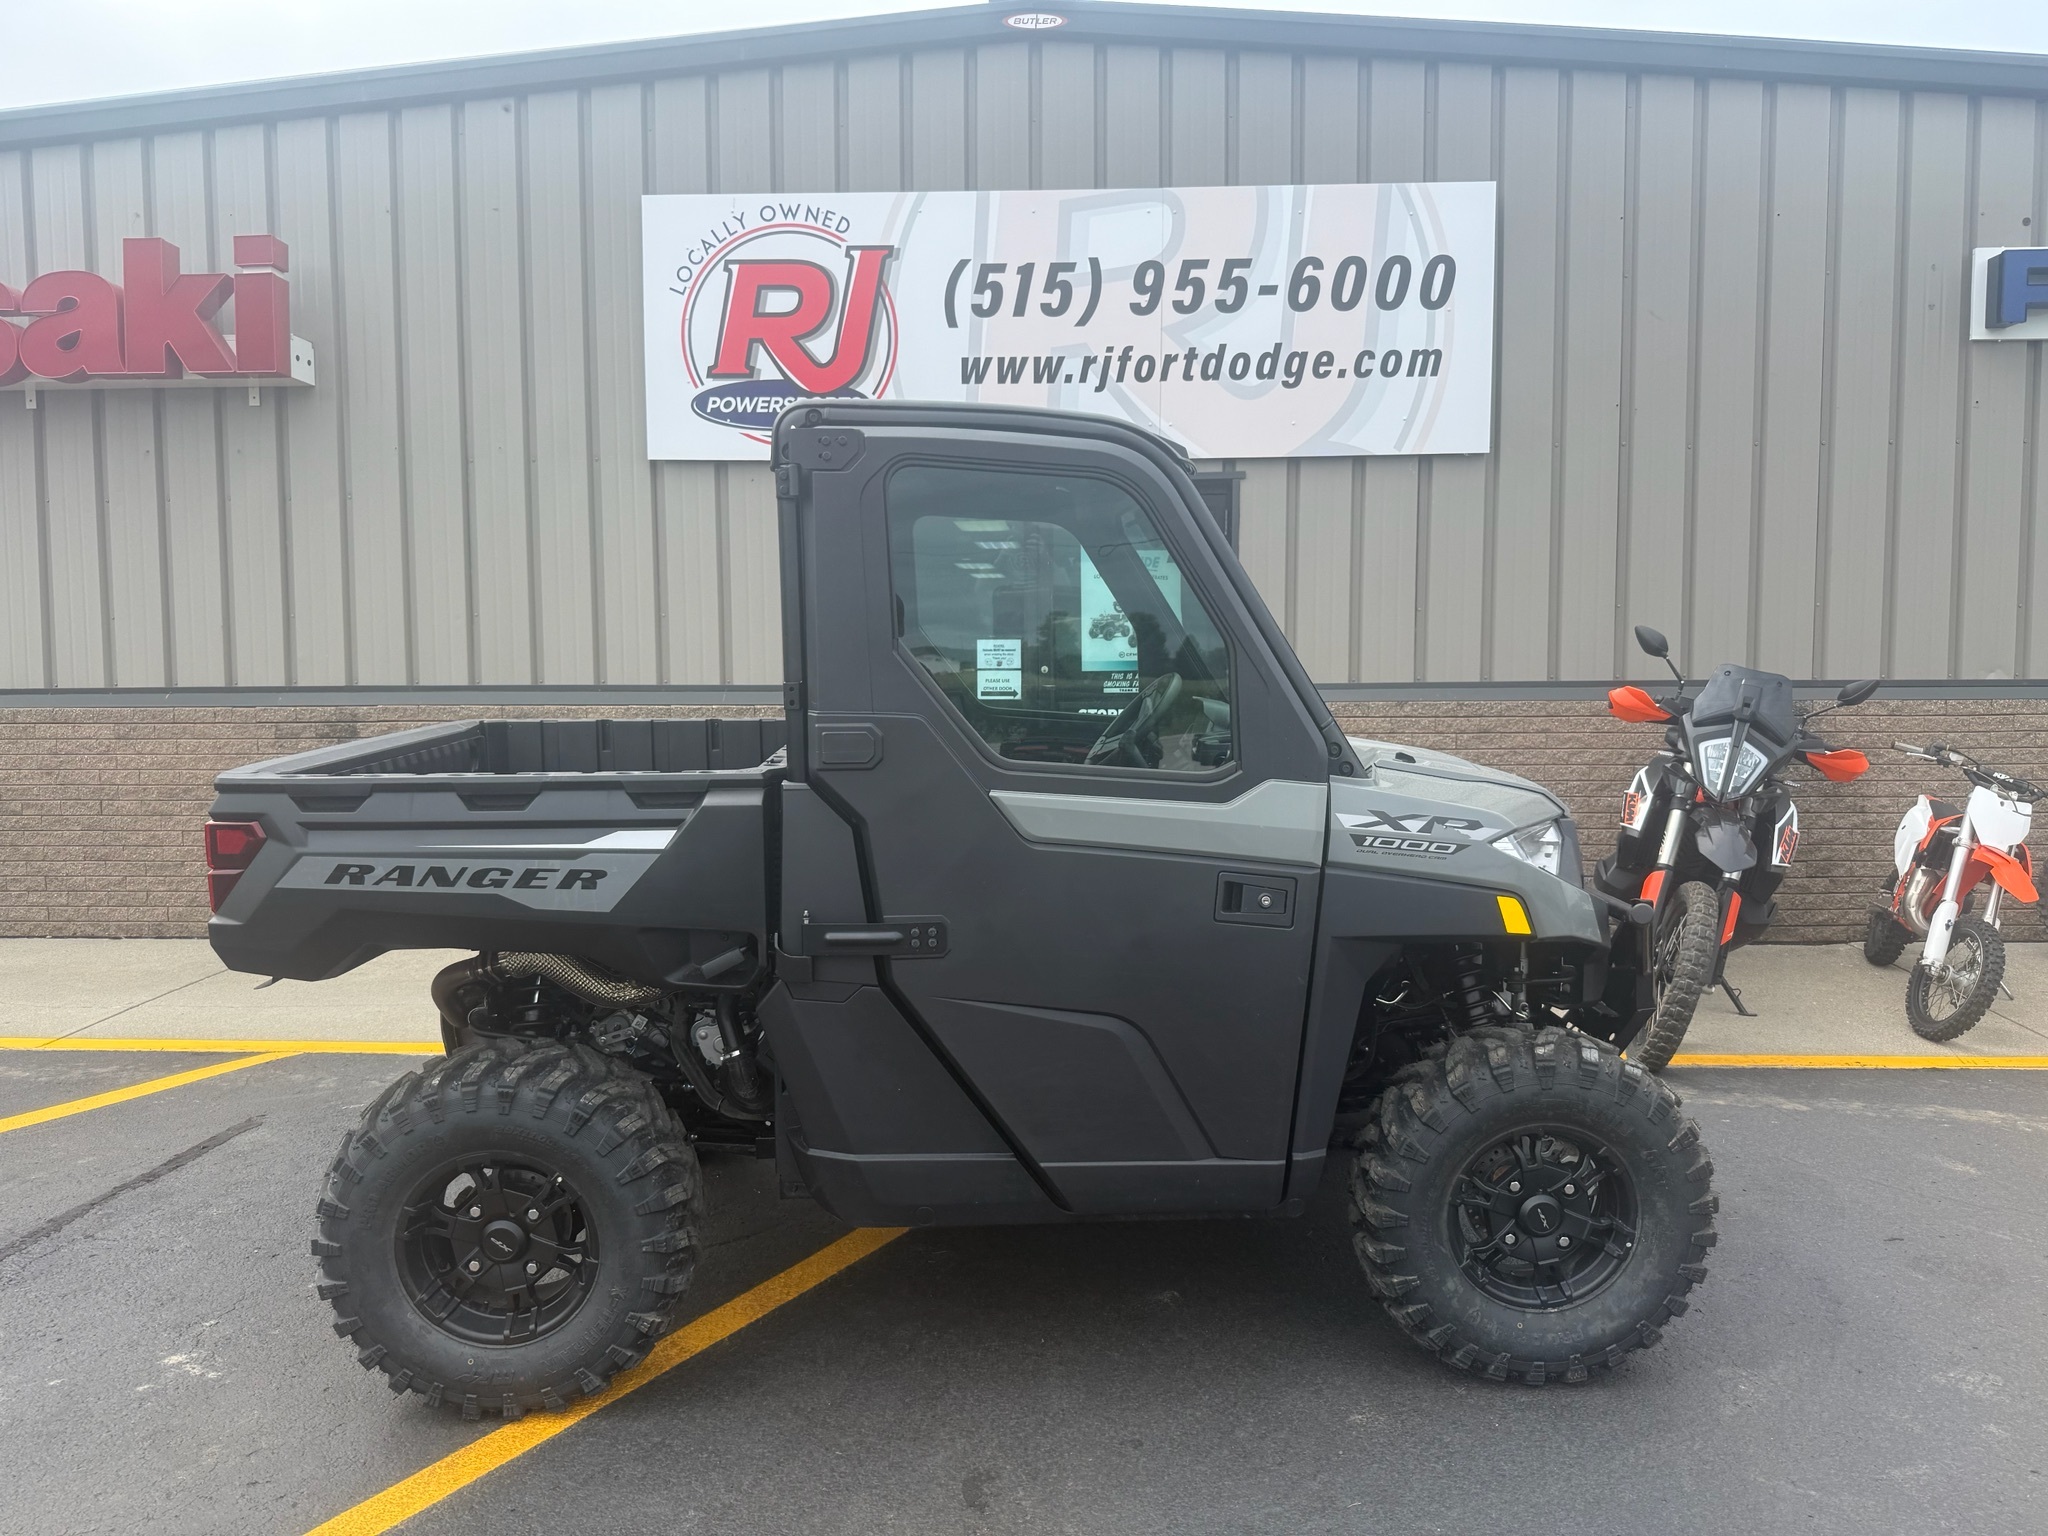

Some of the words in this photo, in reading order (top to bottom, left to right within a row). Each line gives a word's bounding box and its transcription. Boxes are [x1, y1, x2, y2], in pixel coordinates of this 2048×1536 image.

[1013, 17, 1058, 25] BUTLER
[669, 212, 747, 296] LOCALLY
[759, 203, 851, 234] OWNED
[944, 257, 1102, 328] (515)
[1129, 254, 1457, 316] 955-6000
[0, 234, 290, 386] aki
[705, 244, 896, 394] RJ
[960, 342, 1443, 393] www.rjfortdodge.com
[1103, 680, 1130, 688] SMOKING
[1111, 672, 1124, 680] THIS
[1126, 672, 1133, 680] IS
[1349, 809, 1486, 835] XP
[1362, 836, 1457, 854] 1000
[323, 862, 609, 891] RANGER
